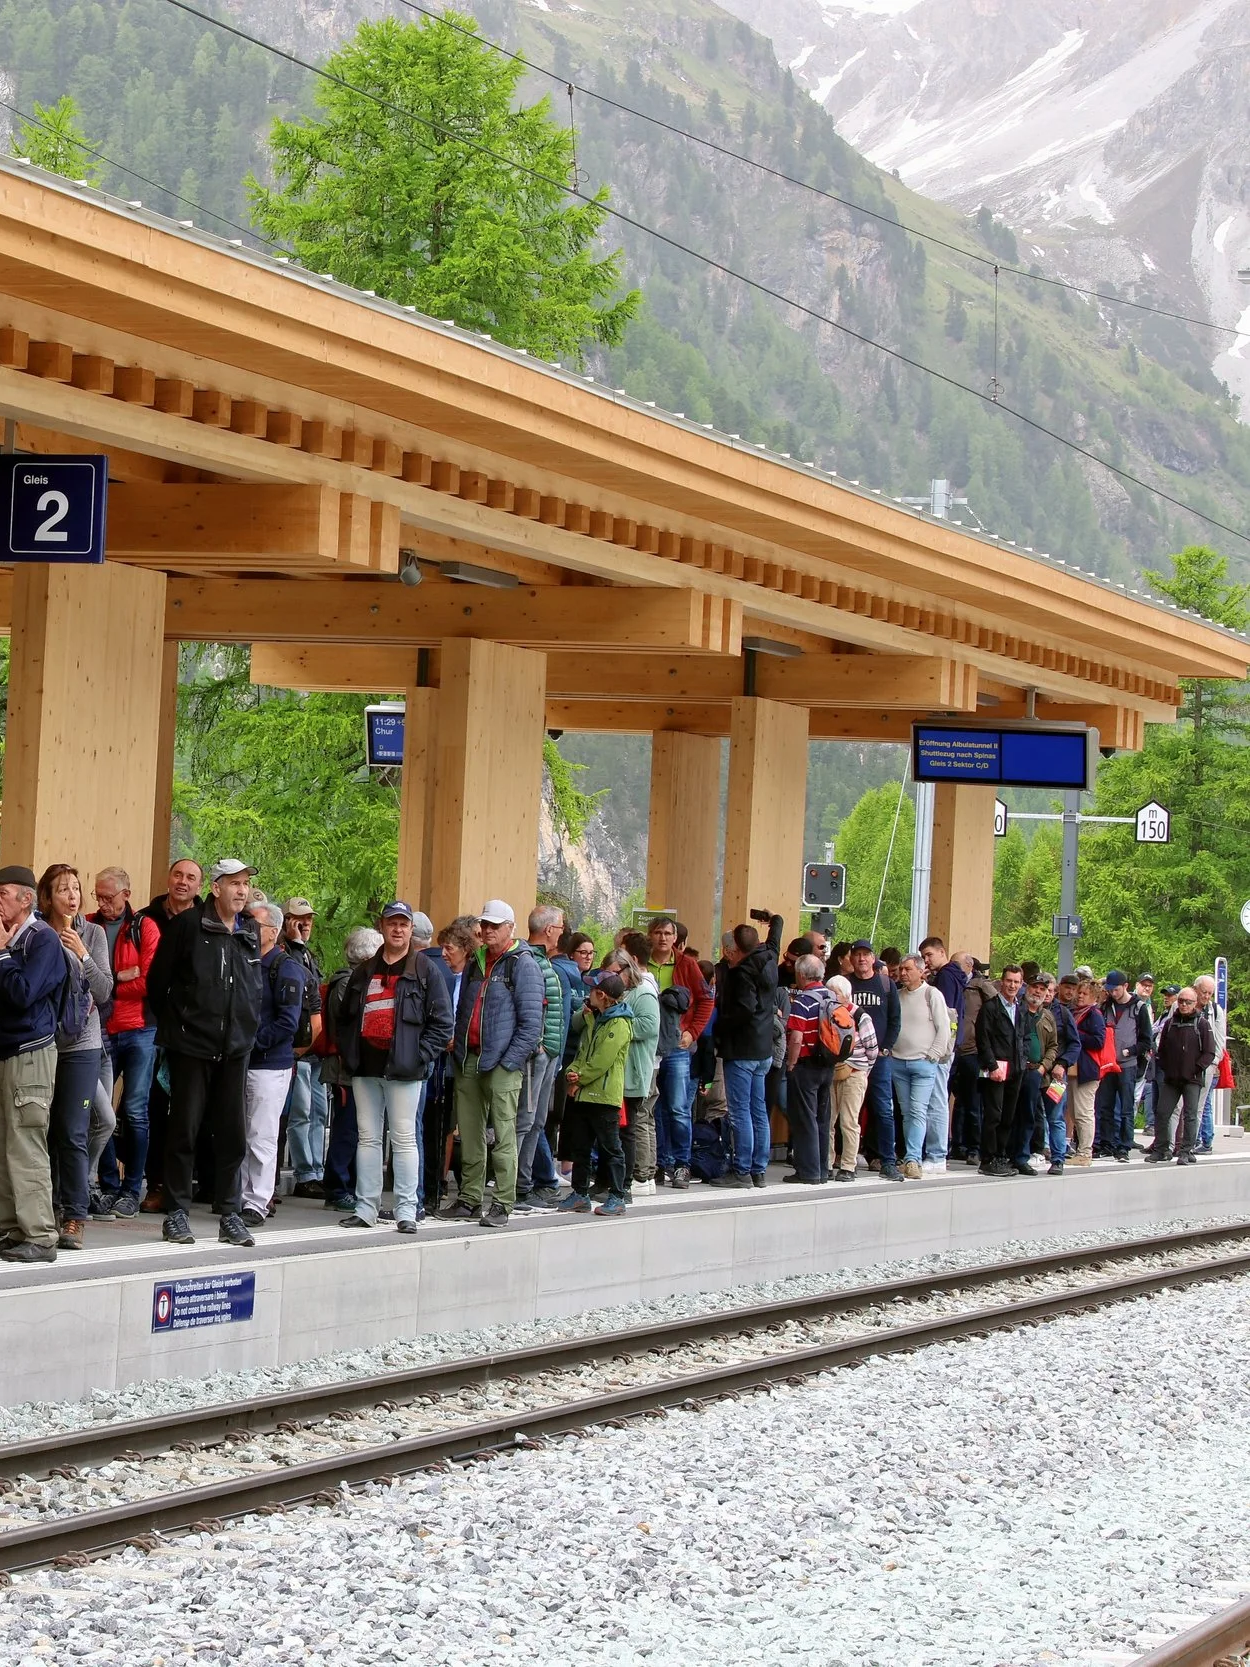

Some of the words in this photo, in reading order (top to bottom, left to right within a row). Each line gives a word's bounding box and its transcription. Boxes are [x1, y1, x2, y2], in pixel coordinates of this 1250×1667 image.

[23, 474, 49, 485] Gleis
[34, 490, 69, 542] 2
[919, 740, 950, 748] Eröffnung
[920, 750, 955, 758] Shuttlezug
[1148, 809, 1158, 818] m
[1141, 820, 1166, 839] 150
[853, 992, 881, 1006] USTANG
[176, 1282, 204, 1293] Überschreiten
[225, 1278, 242, 1286] verboten
[174, 1296, 190, 1304] Vietato
[190, 1293, 214, 1303] attraversare
[216, 1290, 228, 1300] binari
[174, 1308, 180, 1316] Do
[207, 1303, 221, 1312] railway
[222, 1302, 231, 1310] lines
[190, 1317, 196, 1326] de
[196, 1316, 214, 1324] traverser
